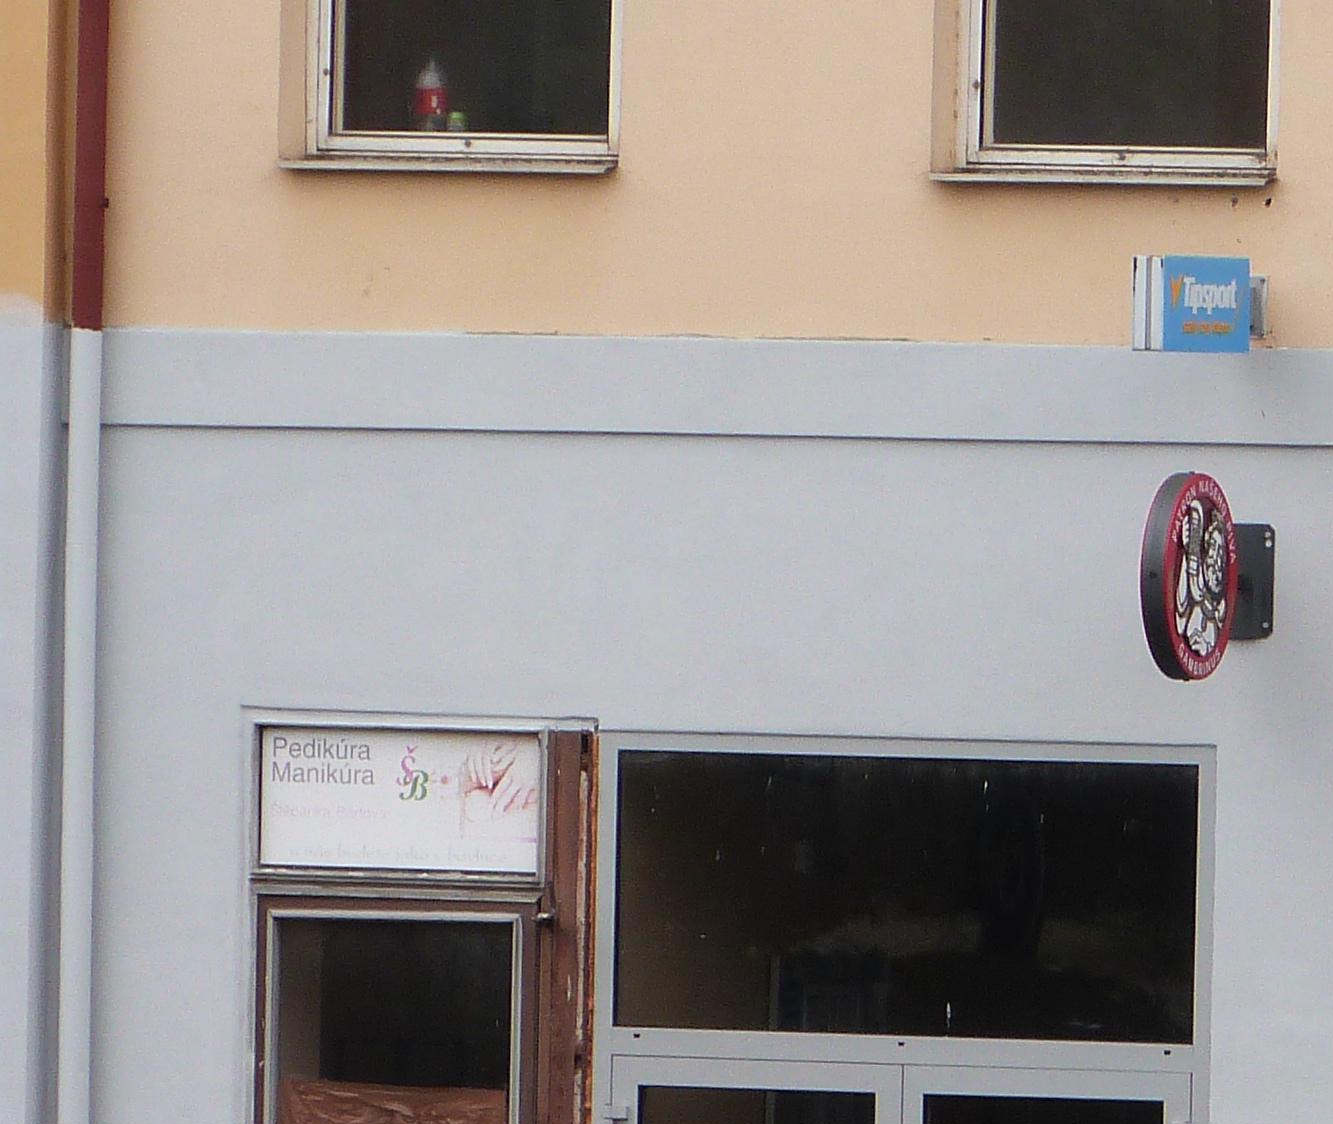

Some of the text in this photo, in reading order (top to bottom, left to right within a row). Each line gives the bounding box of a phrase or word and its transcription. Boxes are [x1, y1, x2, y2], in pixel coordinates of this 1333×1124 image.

[1183, 277, 1237, 315] Tipsport
[1178, 643, 1220, 676] GAMBRINUS
[272, 736, 371, 761] Pedikúra
[271, 761, 375, 786] Manikúra
